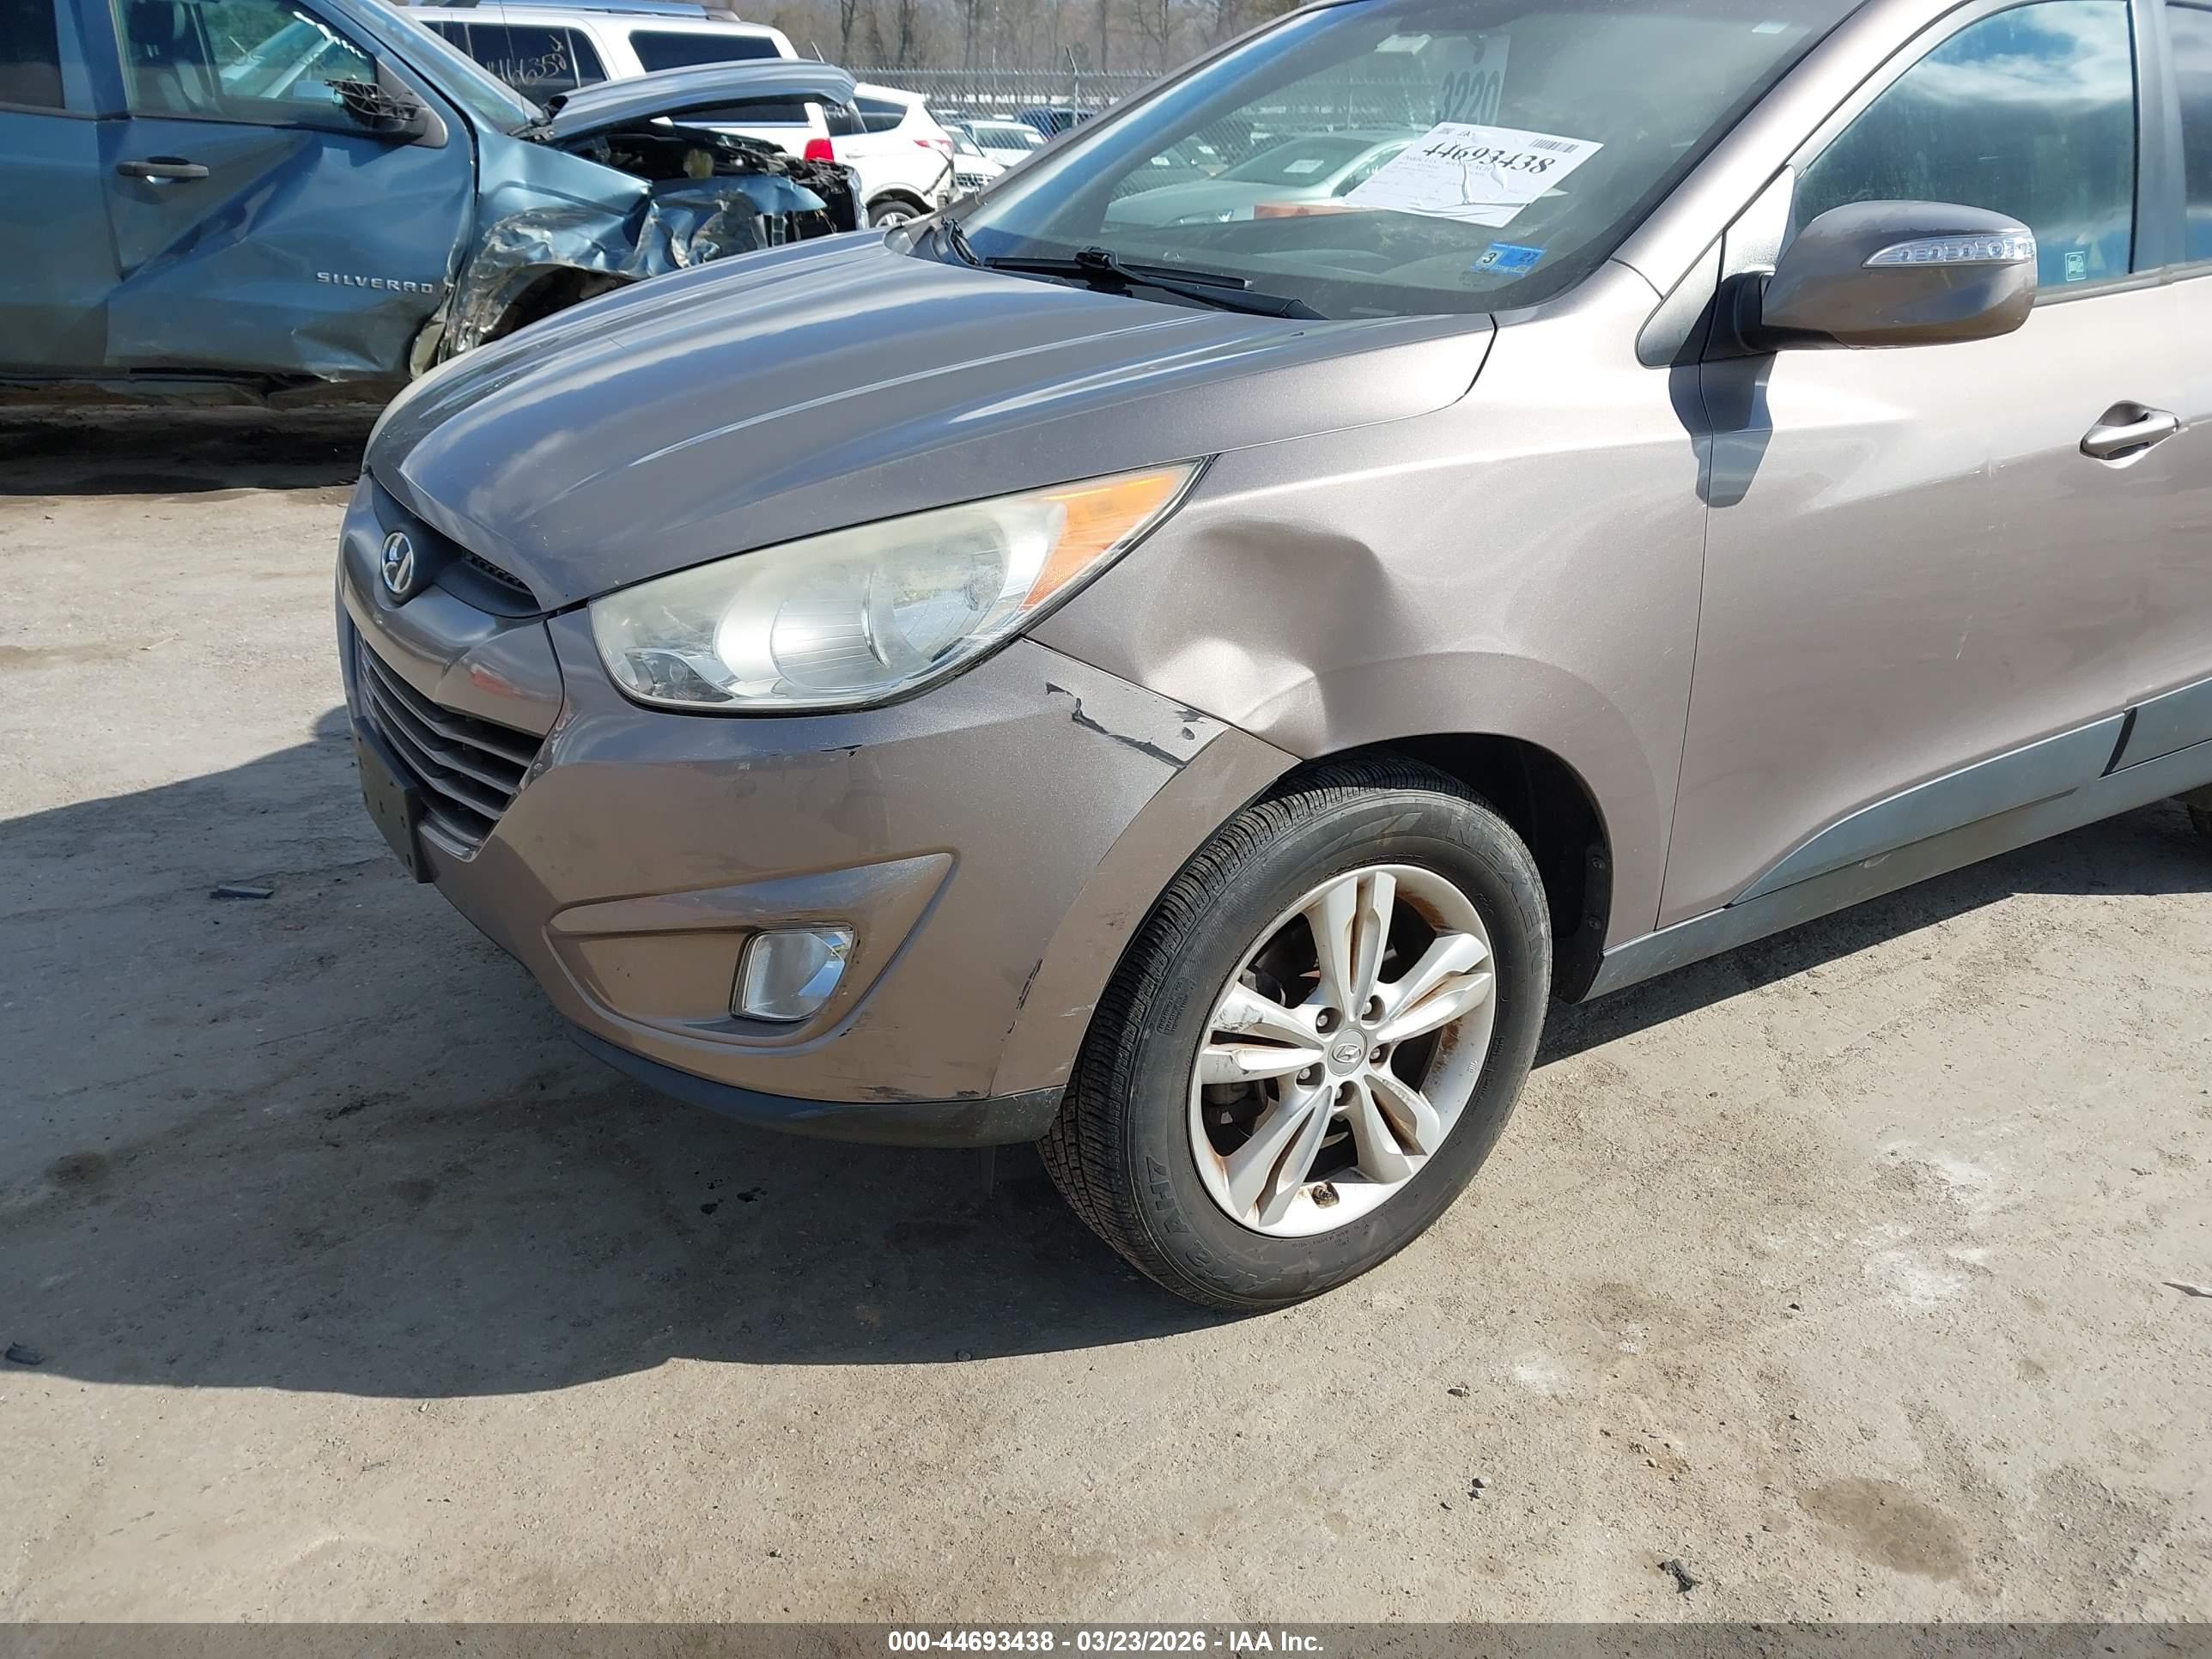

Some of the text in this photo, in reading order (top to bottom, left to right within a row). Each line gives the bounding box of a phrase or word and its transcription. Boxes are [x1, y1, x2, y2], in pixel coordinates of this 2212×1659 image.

[1422, 142, 1556, 173] 44693438
[1482, 252, 1498, 264] 3
[1445, 814, 1547, 976] NEXEN
[1145, 1154, 1192, 1234] AH7
